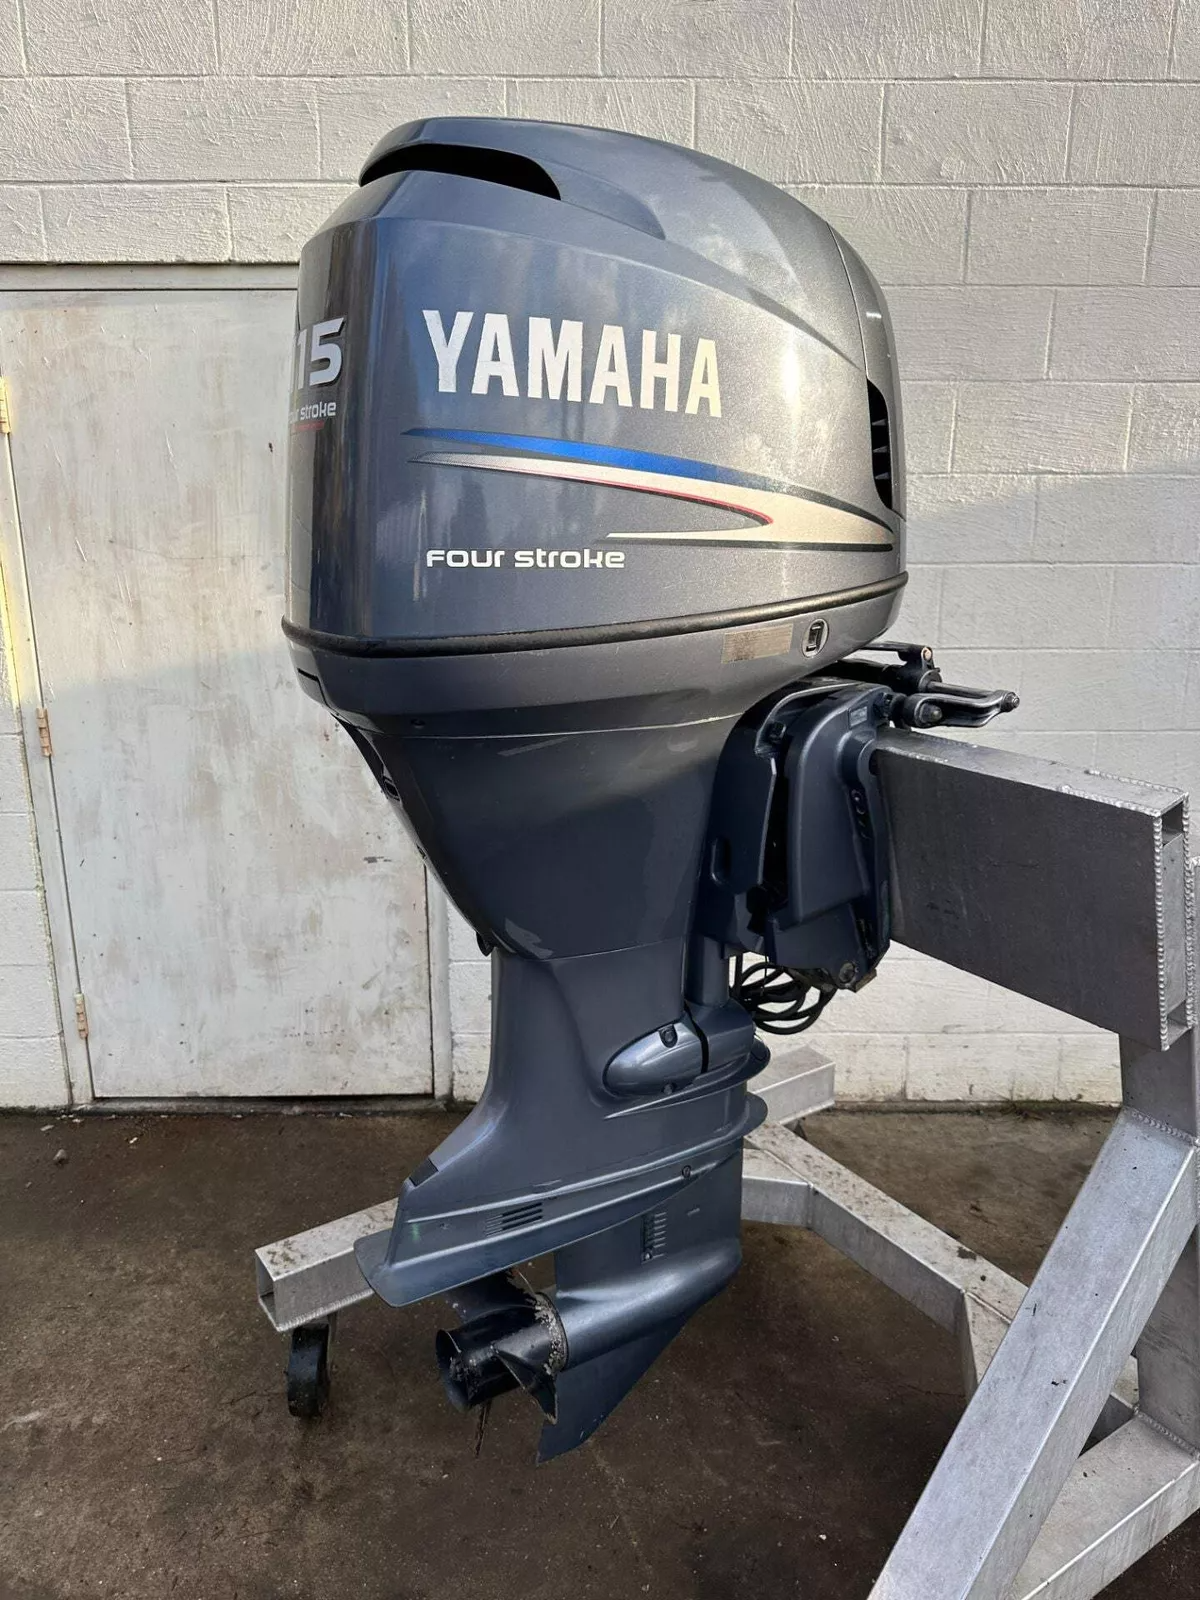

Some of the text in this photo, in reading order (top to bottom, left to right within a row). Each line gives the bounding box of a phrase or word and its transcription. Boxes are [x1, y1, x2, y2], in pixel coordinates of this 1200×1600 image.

[422, 309, 722, 418] YAMAHA
[300, 401, 337, 420] stroke
[514, 548, 626, 568] stroke
